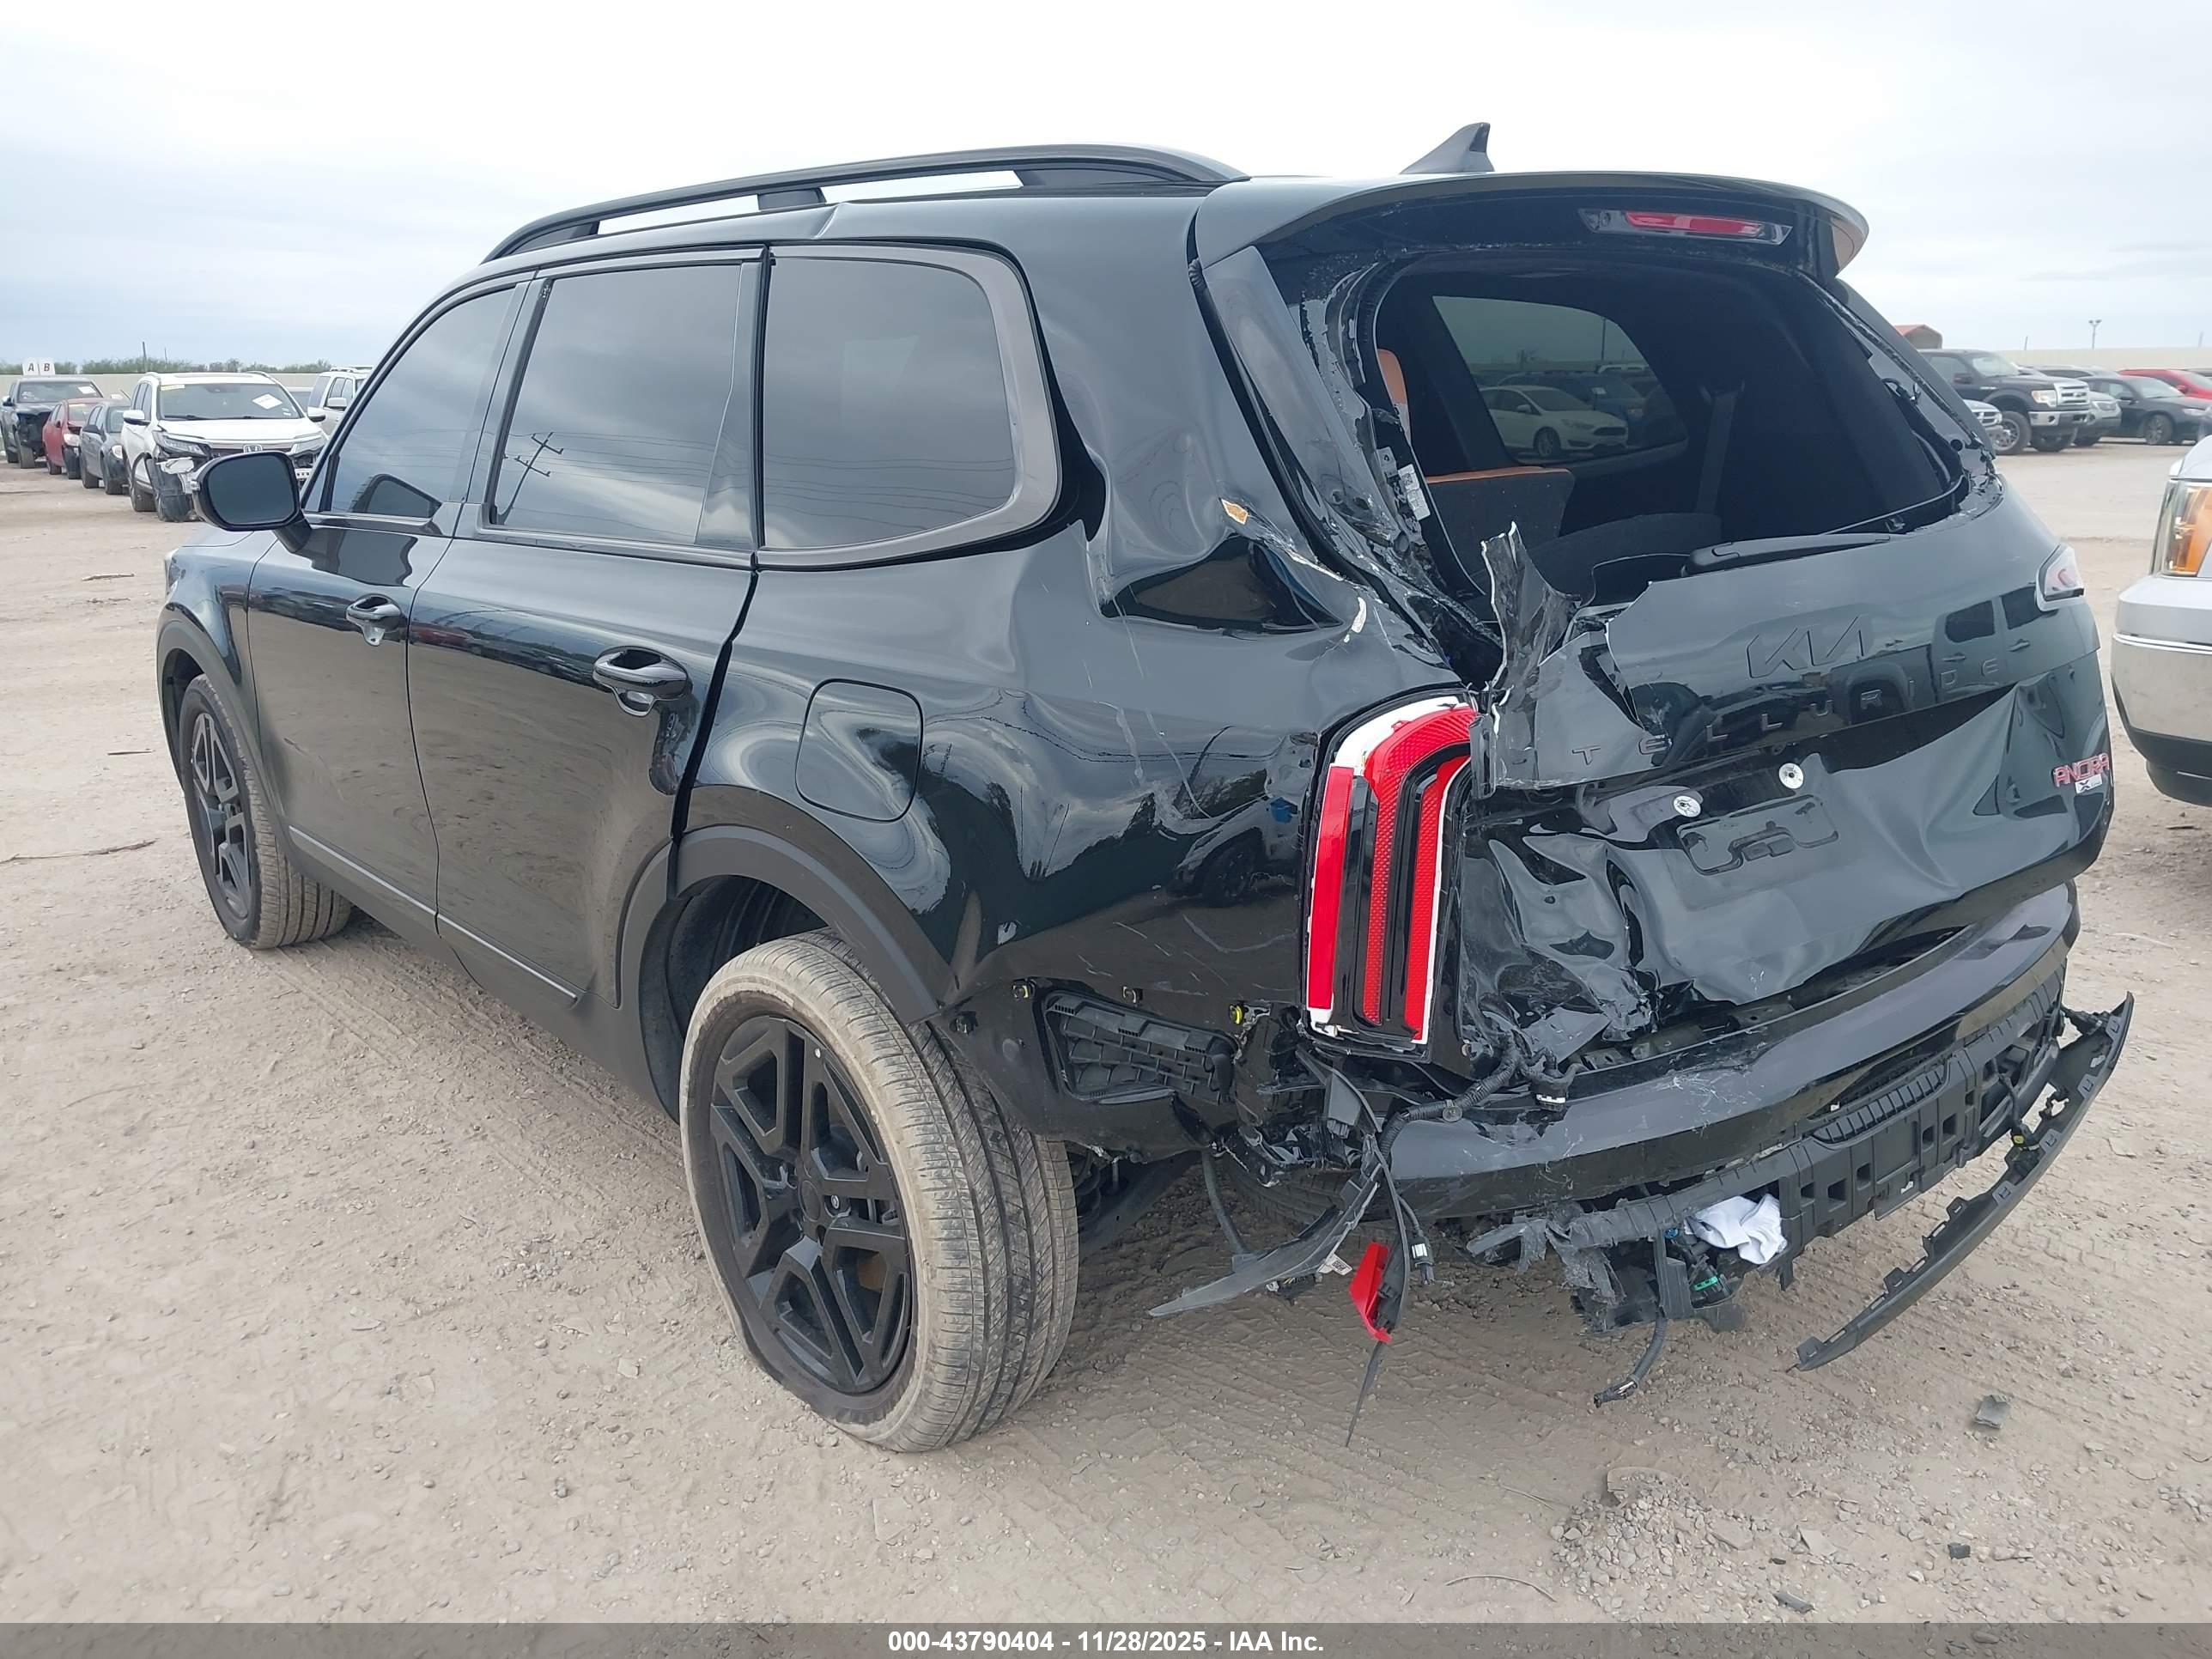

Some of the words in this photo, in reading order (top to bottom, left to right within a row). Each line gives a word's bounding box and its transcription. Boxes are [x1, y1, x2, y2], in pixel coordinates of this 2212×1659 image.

[27, 362, 35, 372] A
[43, 362, 51, 372] B
[1746, 612, 1872, 679] KIA
[1571, 658, 2000, 766] TELLURIDE
